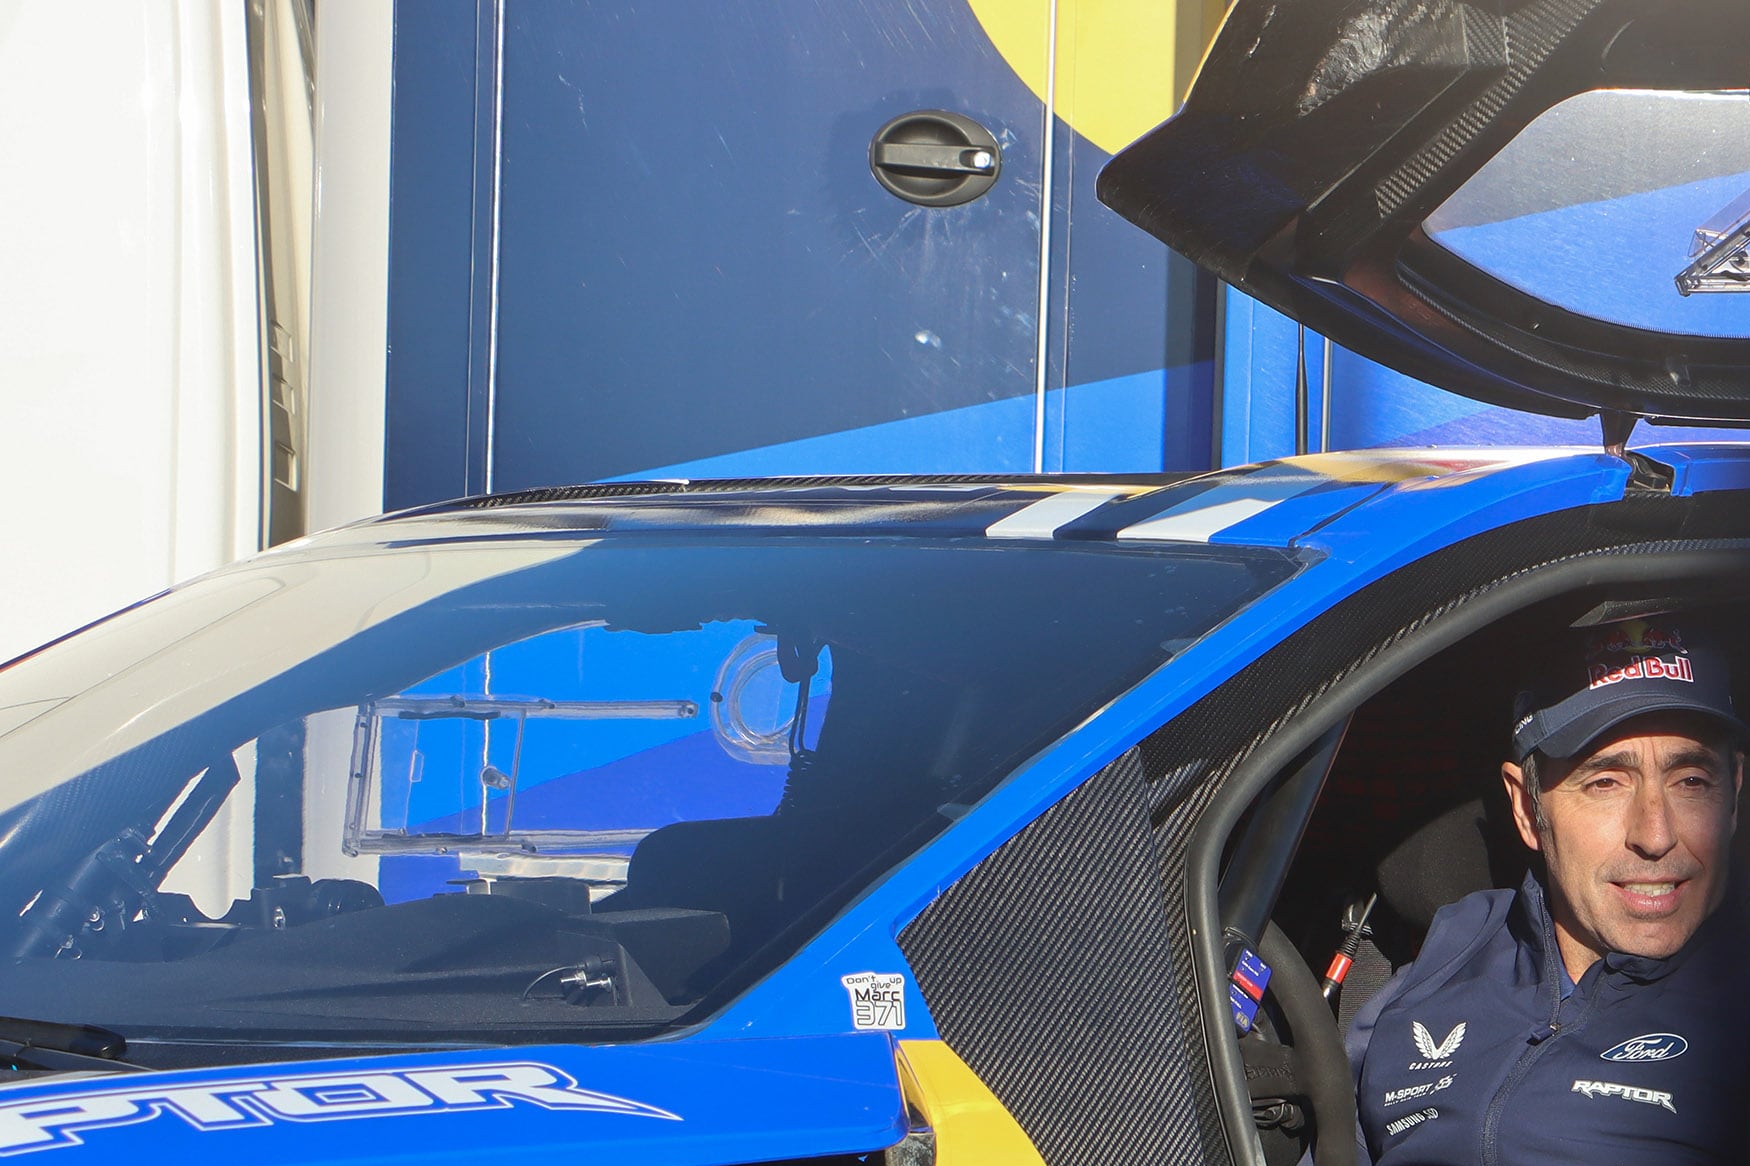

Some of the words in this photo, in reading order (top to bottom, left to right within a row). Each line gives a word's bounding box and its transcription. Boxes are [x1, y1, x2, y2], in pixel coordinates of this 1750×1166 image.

[1587, 656, 1642, 690] Red
[1643, 656, 1694, 682] Bull
[846, 975, 876, 985] Don't
[889, 977, 902, 985] up
[854, 988, 900, 1002] Marc
[855, 1000, 903, 1027] 371
[1613, 1038, 1674, 1060] Ford
[1385, 1083, 1434, 1102] M-SPORT
[1571, 1080, 1677, 1114] RAPTOR
[1387, 1112, 1425, 1136] SAMSUNG
